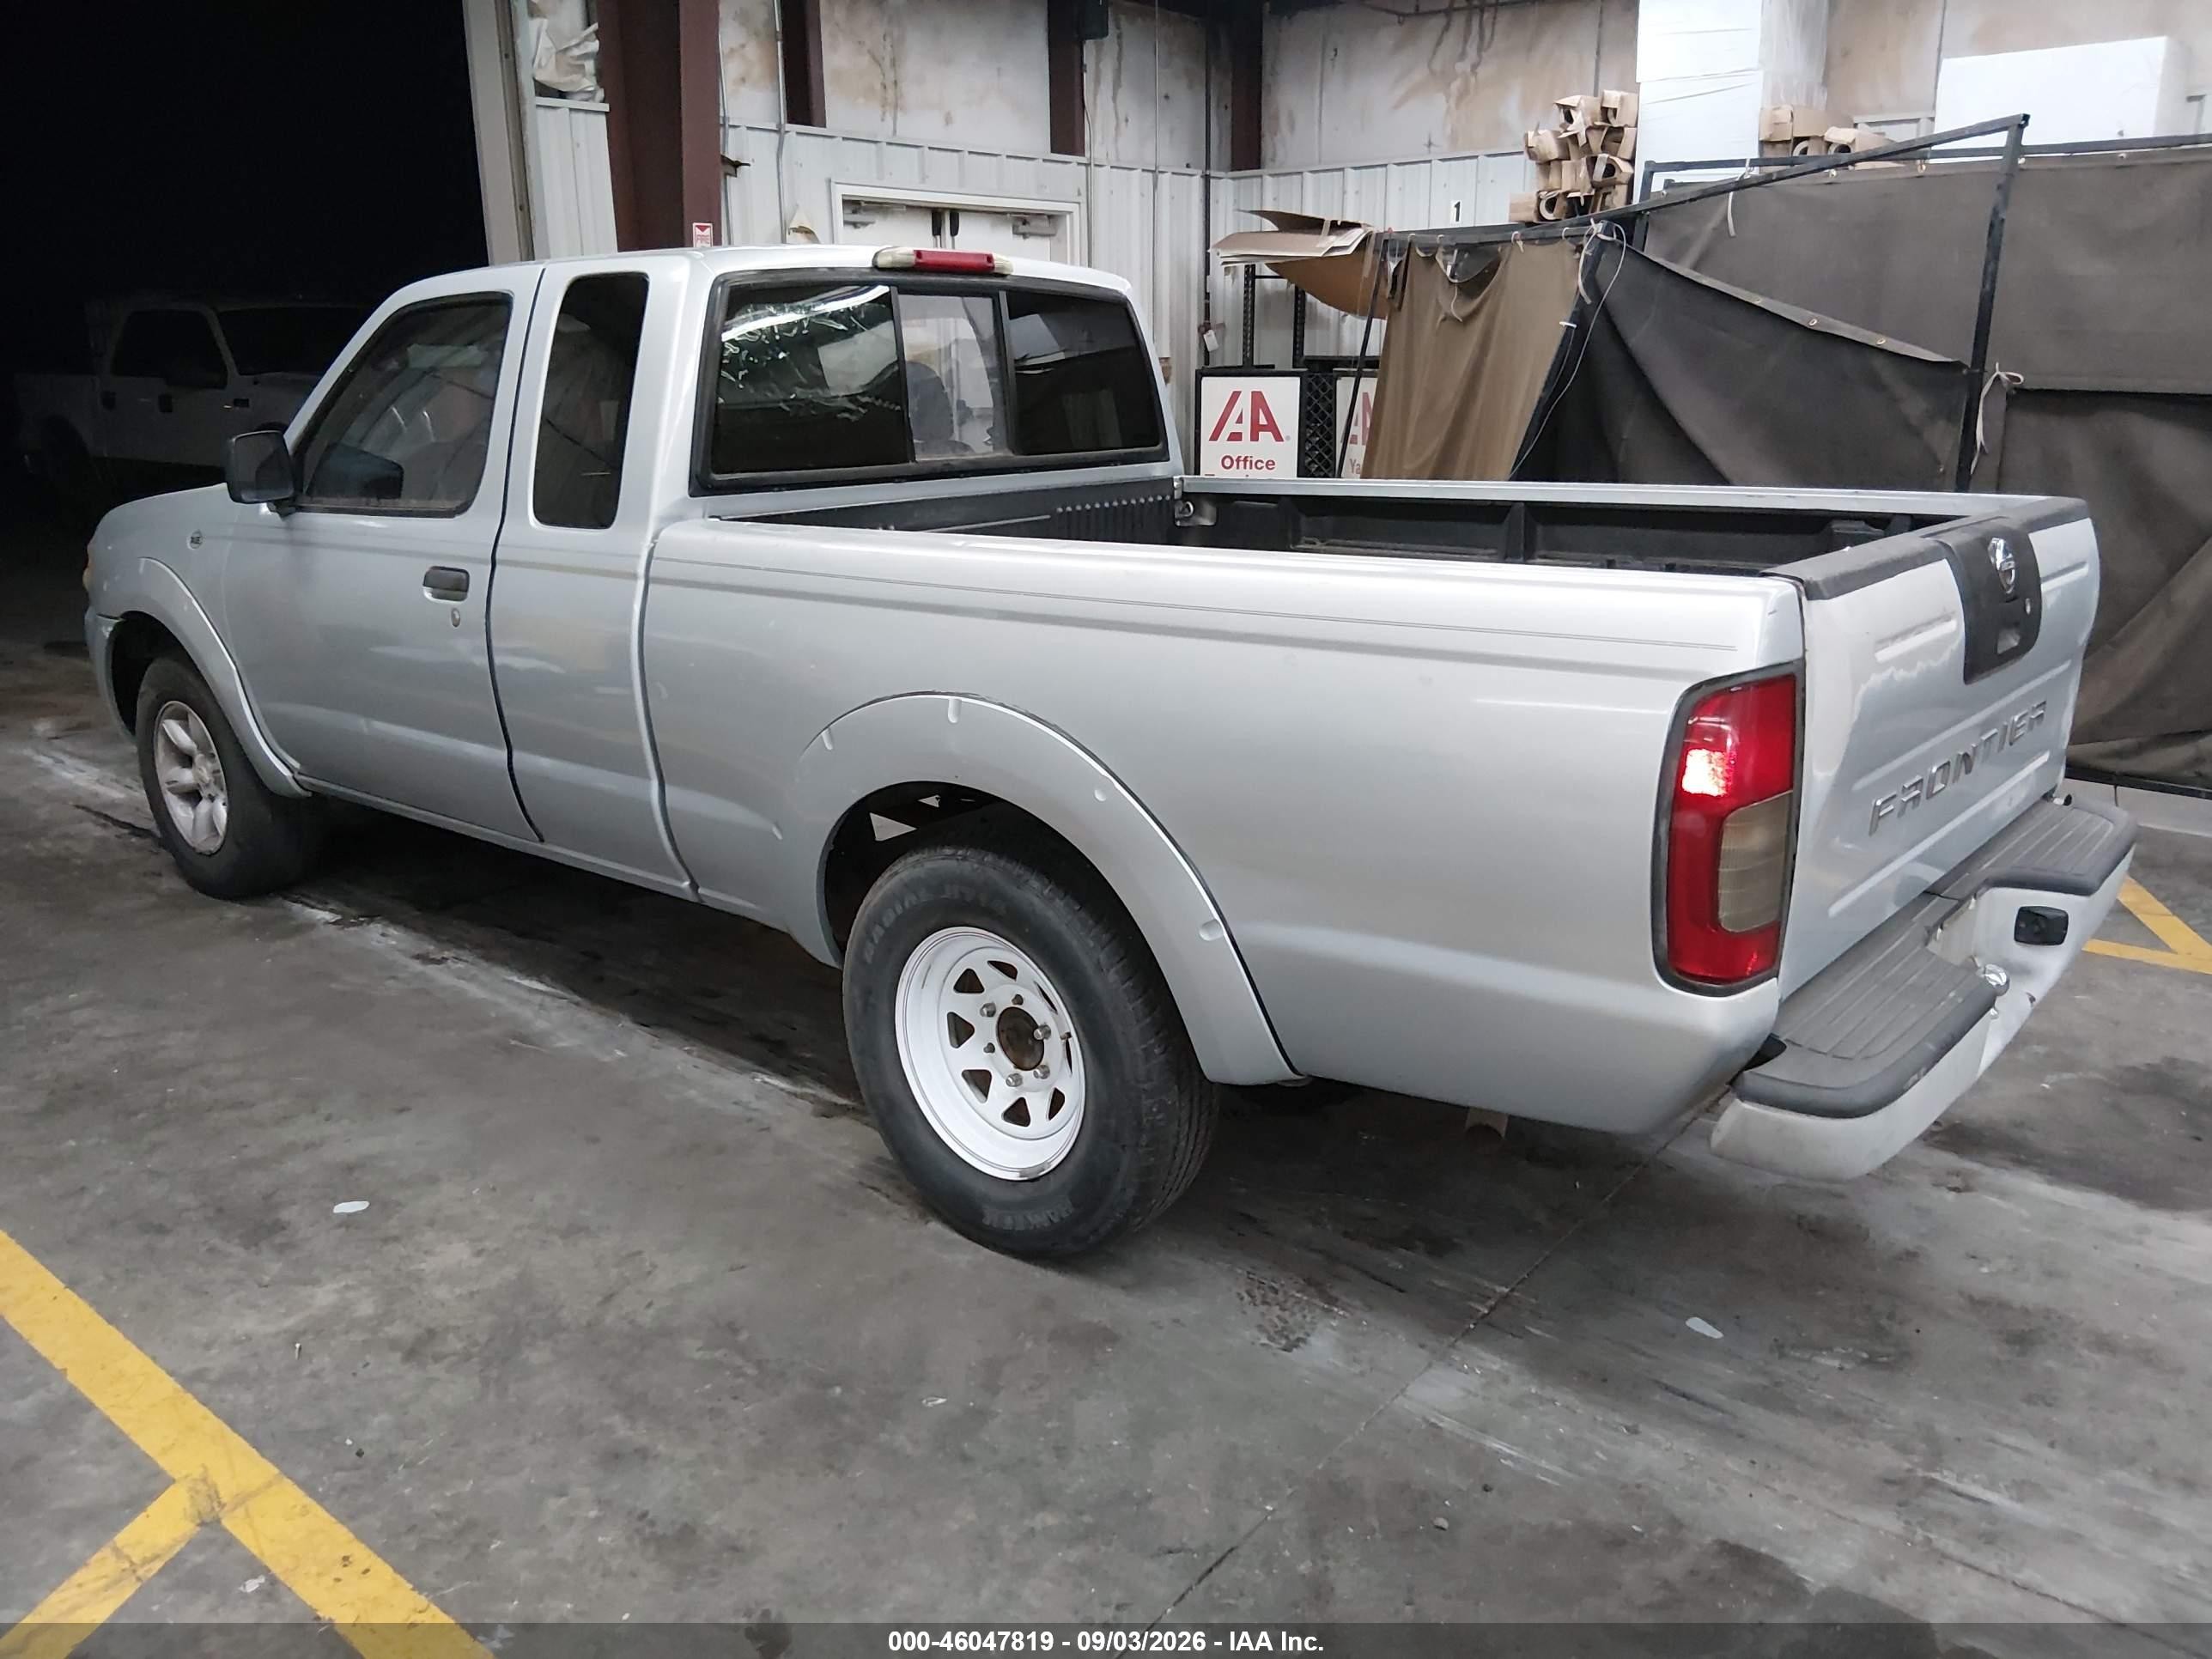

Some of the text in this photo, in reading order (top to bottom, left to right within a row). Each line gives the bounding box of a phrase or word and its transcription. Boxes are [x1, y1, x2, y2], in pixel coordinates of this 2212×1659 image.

[1454, 201, 1461, 222] 1
[1221, 455, 1276, 471] Office
[1349, 459, 1361, 475] Ya
[1868, 700, 2047, 837] FRONTIER
